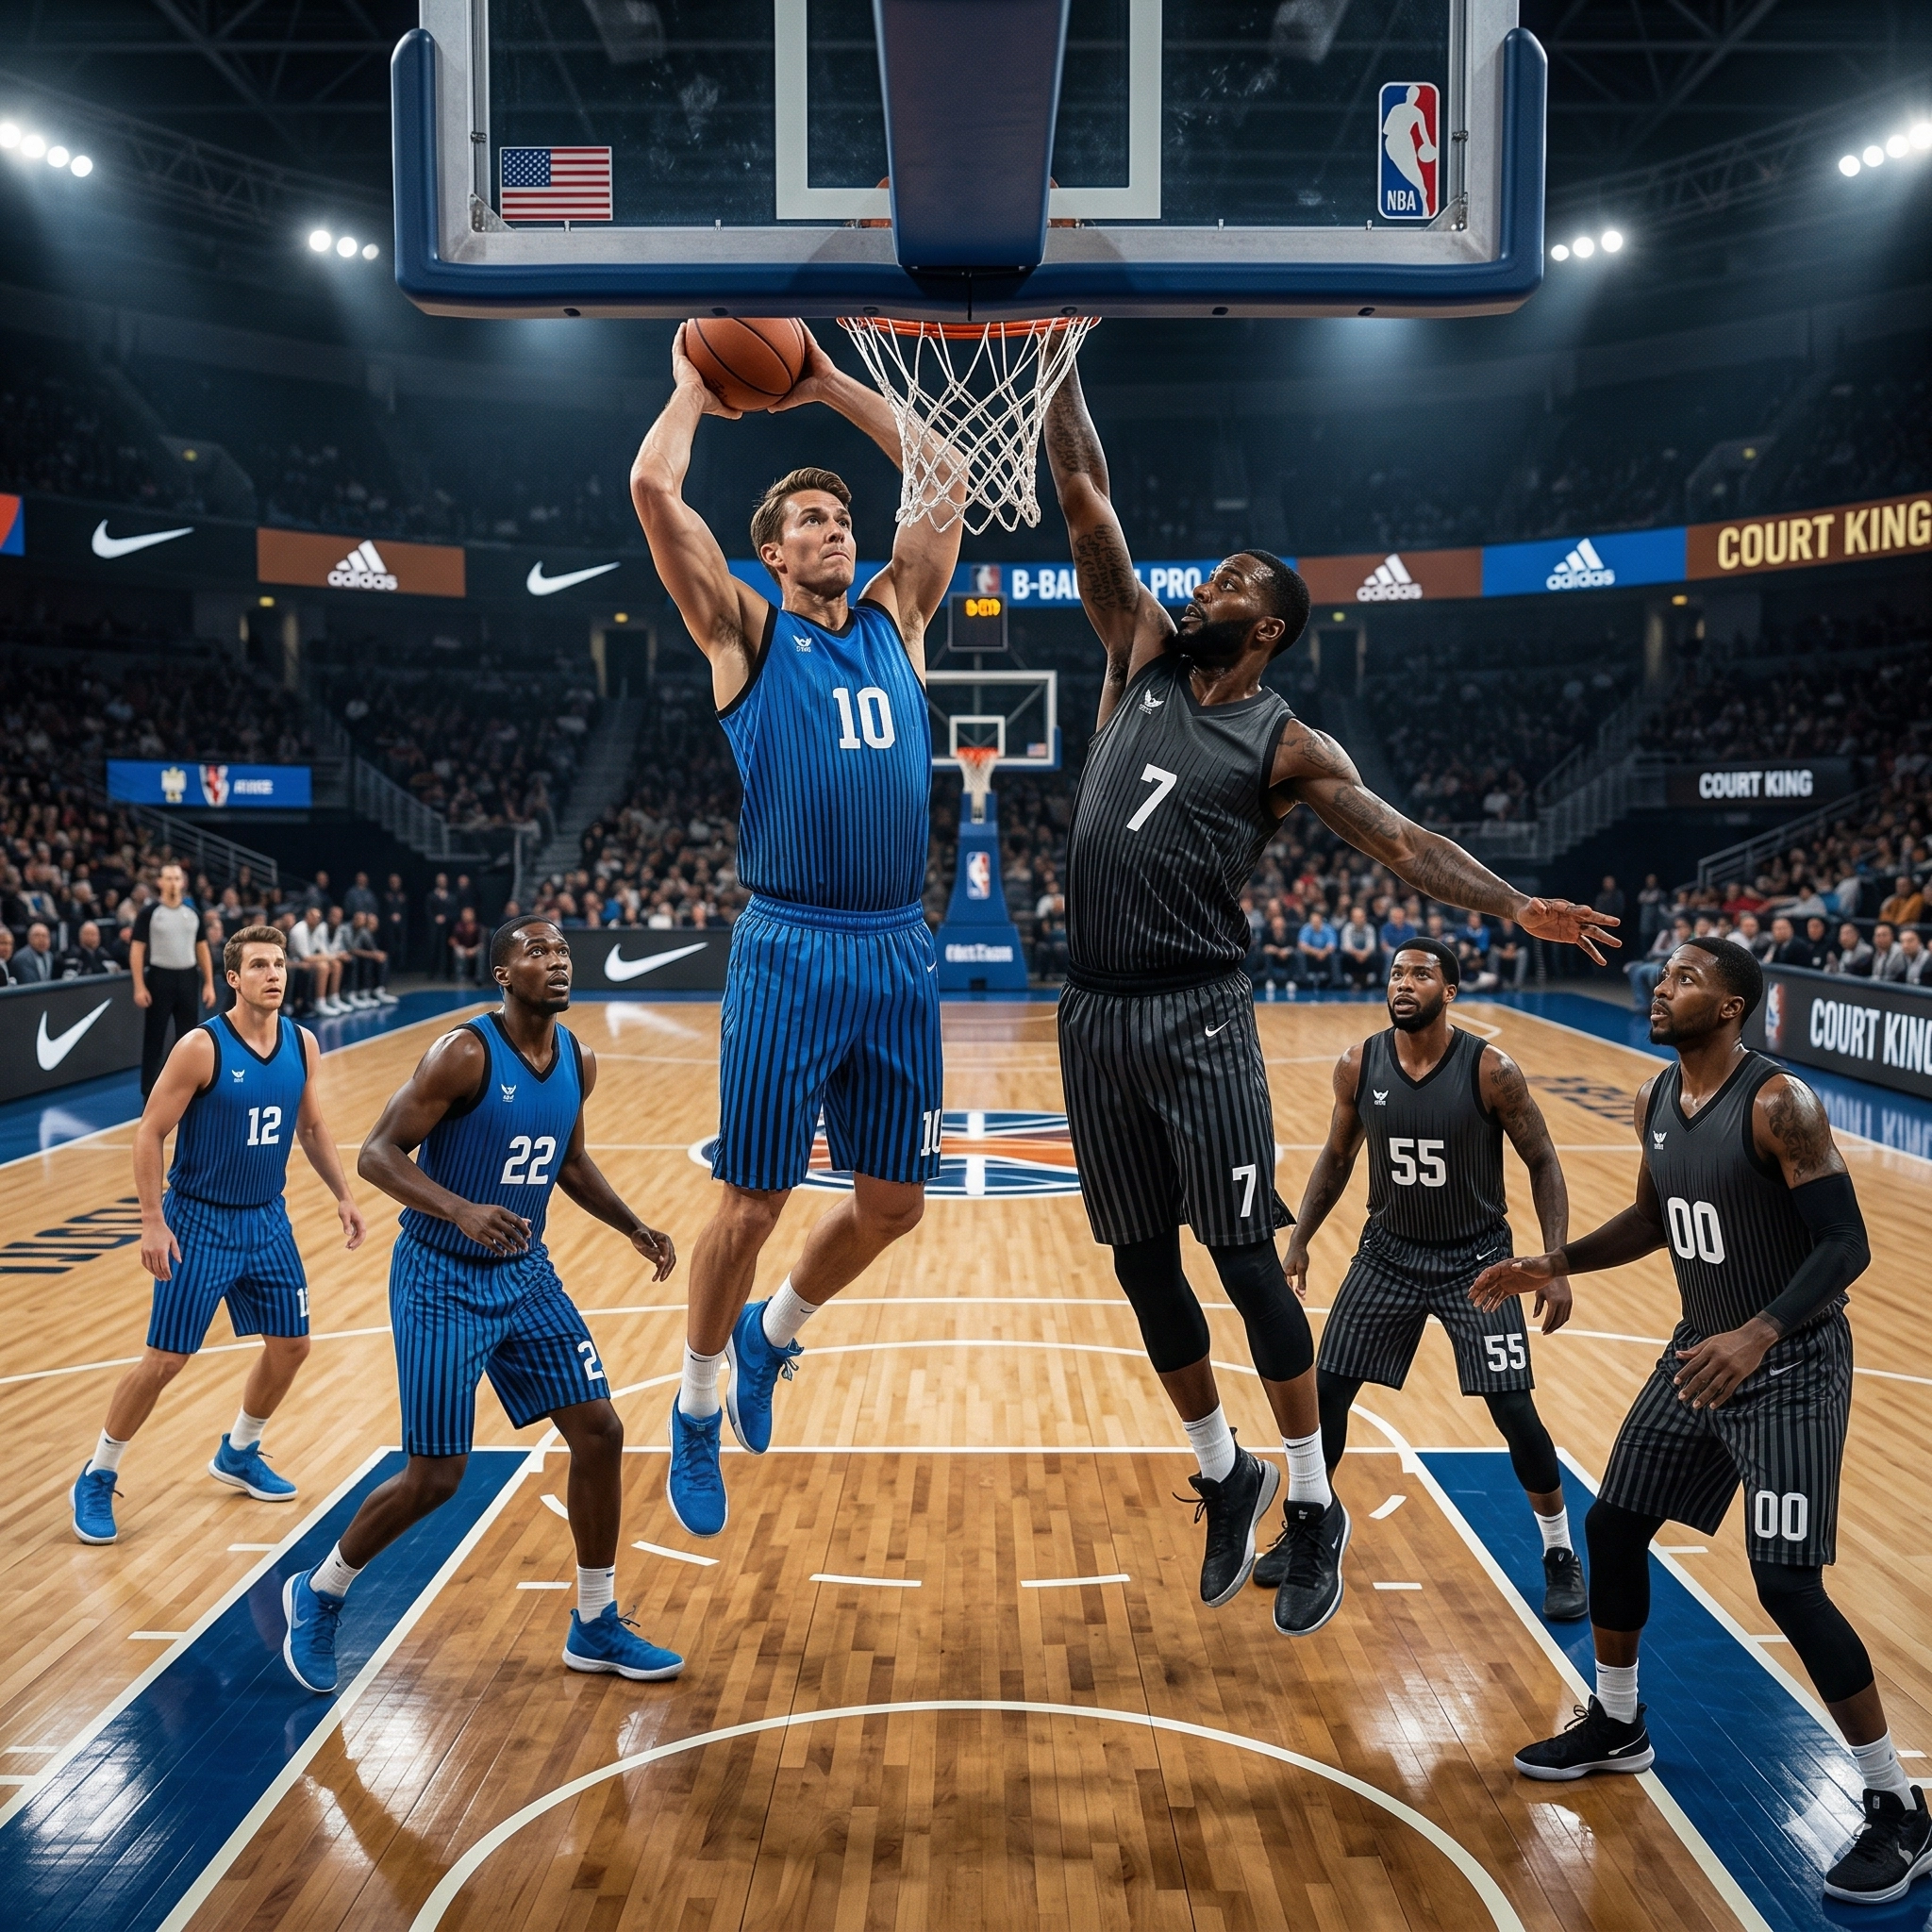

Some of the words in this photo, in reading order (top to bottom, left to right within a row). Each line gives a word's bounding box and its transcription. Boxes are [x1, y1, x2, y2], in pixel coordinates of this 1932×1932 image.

[1387, 190, 1416, 211] NBA
[1717, 513, 1836, 571] COURT
[1843, 499, 1932, 556] KING
[326, 570, 398, 591] adidas
[1356, 582, 1423, 602] adidas
[1545, 569, 1615, 591] adidas
[832, 687, 895, 749] 10
[1125, 763, 1177, 832] 7
[1699, 772, 1763, 799] COURT
[1764, 769, 1813, 798] KING
[1810, 997, 1880, 1061] COURT
[247, 1106, 282, 1146] 12
[500, 1135, 557, 1185] 22
[1389, 1137, 1447, 1188] 55
[1232, 1163, 1257, 1218] 7
[1667, 1196, 1725, 1265] 00
[1483, 1332, 1526, 1372] 55
[1755, 1490, 1808, 1541] 00
